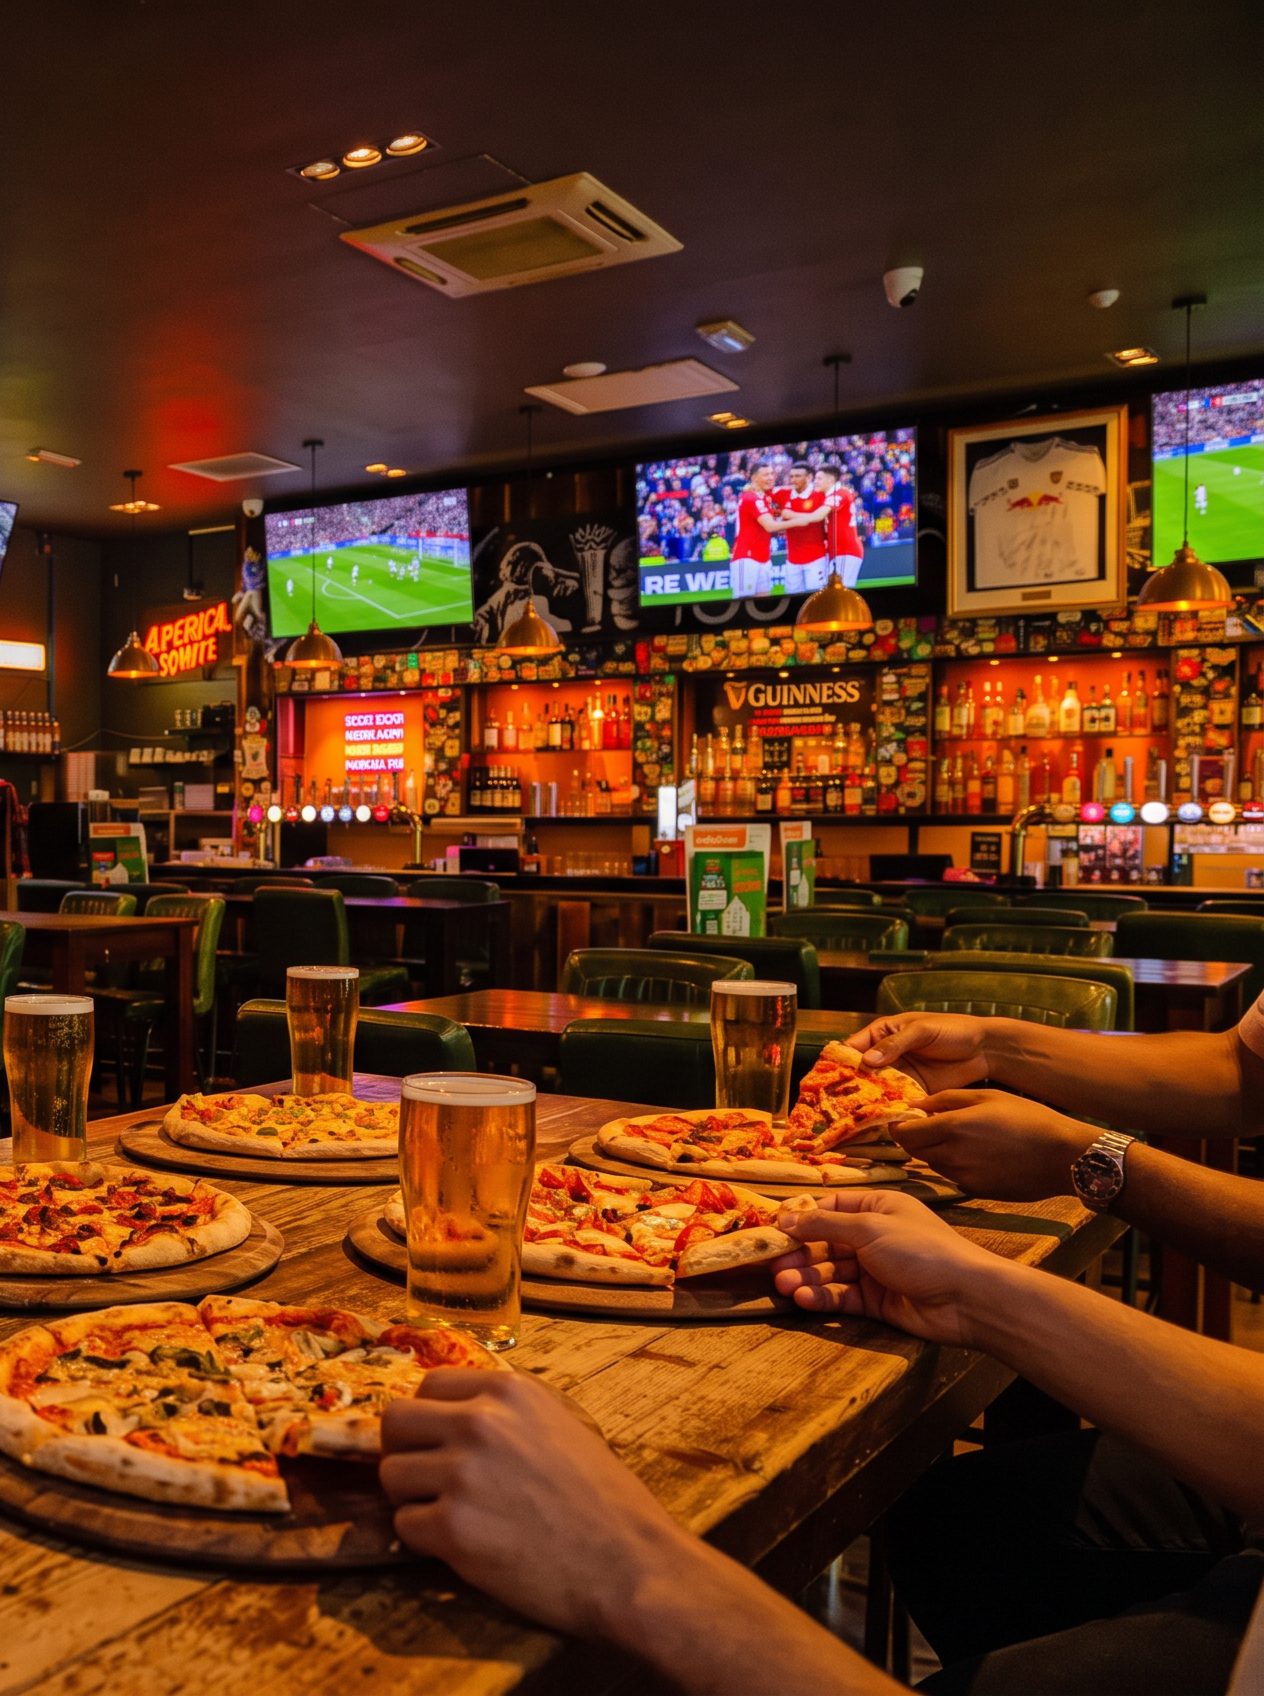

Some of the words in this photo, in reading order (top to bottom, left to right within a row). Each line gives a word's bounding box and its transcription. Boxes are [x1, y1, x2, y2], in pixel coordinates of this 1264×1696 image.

[644, 573, 681, 595] RE
[685, 569, 730, 592] WE
[747, 681, 860, 707] GUINNESS
